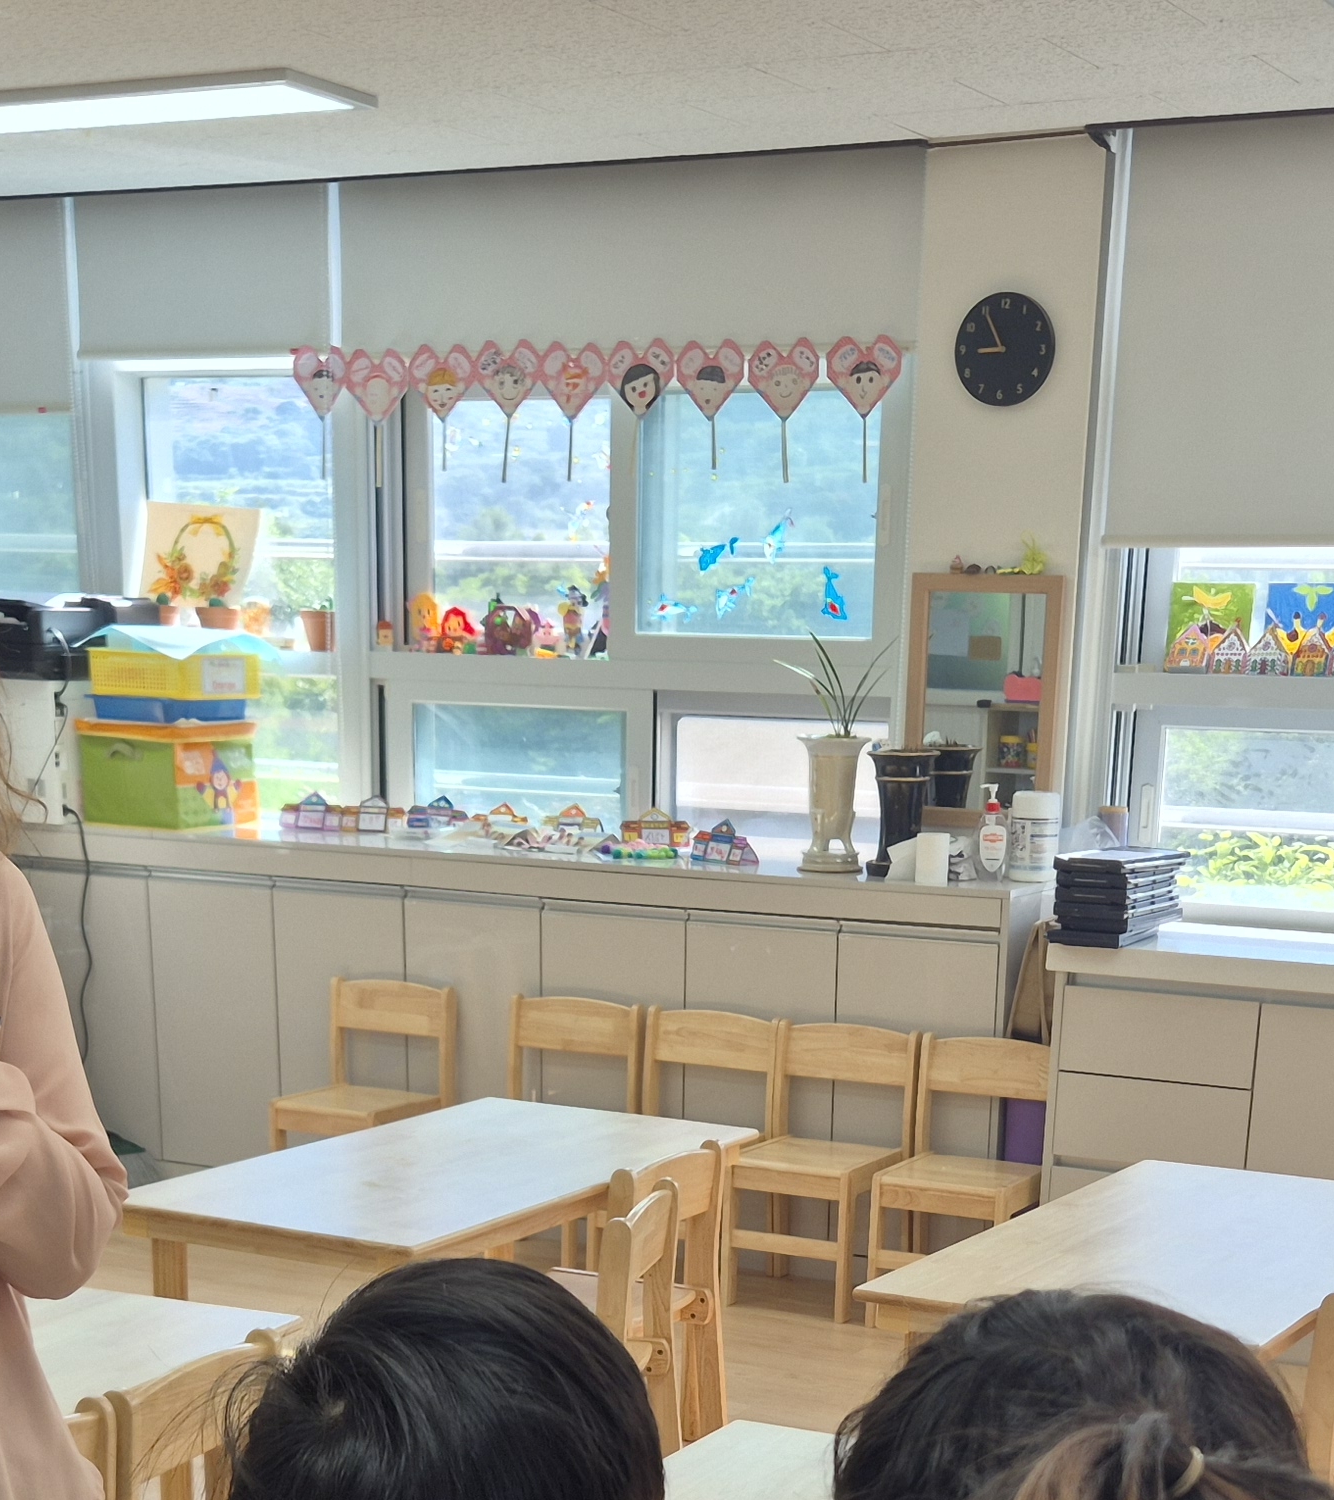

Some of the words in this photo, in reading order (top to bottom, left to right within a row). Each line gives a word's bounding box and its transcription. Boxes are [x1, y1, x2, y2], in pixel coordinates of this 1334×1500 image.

[1001, 298, 1011, 310] 12
[1022, 304, 1028, 316] 1
[966, 322, 976, 333] 10
[1035, 321, 1042, 331] 2
[959, 345, 966, 355] 9
[1039, 344, 1047, 355] 3
[964, 368, 971, 378] 8
[1031, 367, 1039, 378] 4
[978, 383, 985, 395] 7
[1016, 383, 1024, 394] 5
[996, 389, 1003, 400] 6
